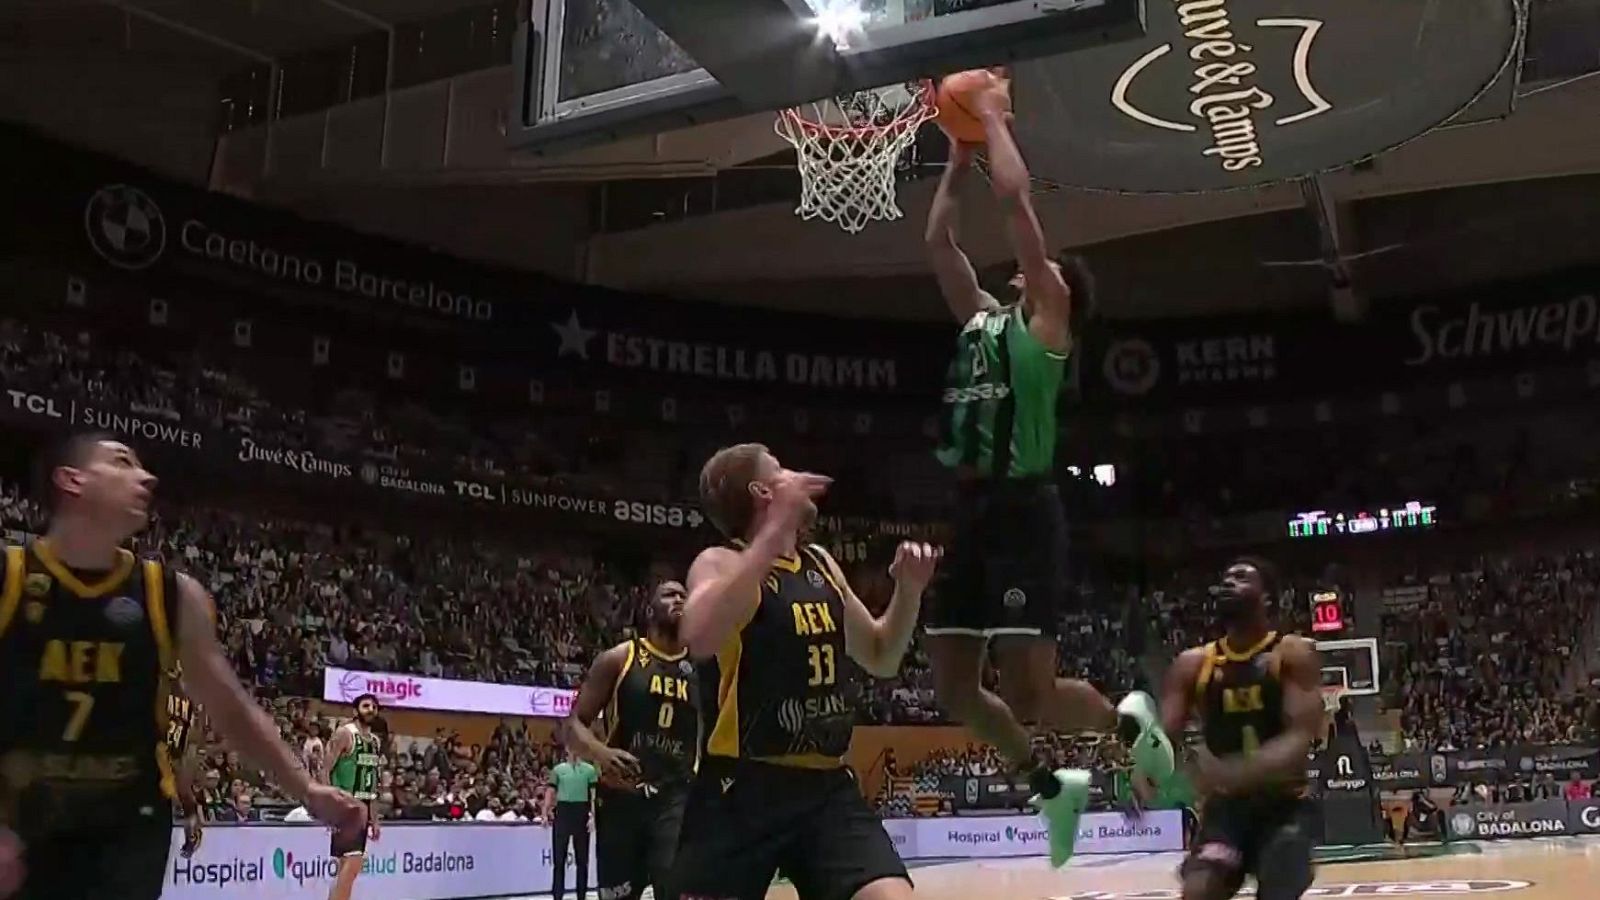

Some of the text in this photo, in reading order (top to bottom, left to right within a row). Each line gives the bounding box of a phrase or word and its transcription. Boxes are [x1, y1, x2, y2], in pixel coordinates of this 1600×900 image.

[1176, 0, 1275, 171] uvé&Camps
[181, 219, 493, 321] Caetano Barcelona
[1403, 294, 1600, 366] Schwep
[606, 331, 898, 387] ESTRELLA DAMM
[1175, 335, 1274, 366] KERN
[7, 389, 202, 449] TCL SUNPOWER
[238, 437, 353, 479] Juvé&Camps
[454, 480, 607, 515] TCL SUNPOWER
[790, 602, 837, 636] AEK
[1315, 603, 1338, 623] 10
[808, 643, 836, 687] 33
[649, 674, 689, 702] AEK
[62, 690, 96, 742] 7
[658, 701, 674, 729] 0
[948, 829, 1000, 845] Hospital
[1477, 818, 1565, 836] BADALONA
[173, 857, 264, 888] Hospital
[402, 851, 475, 874] Badalona
